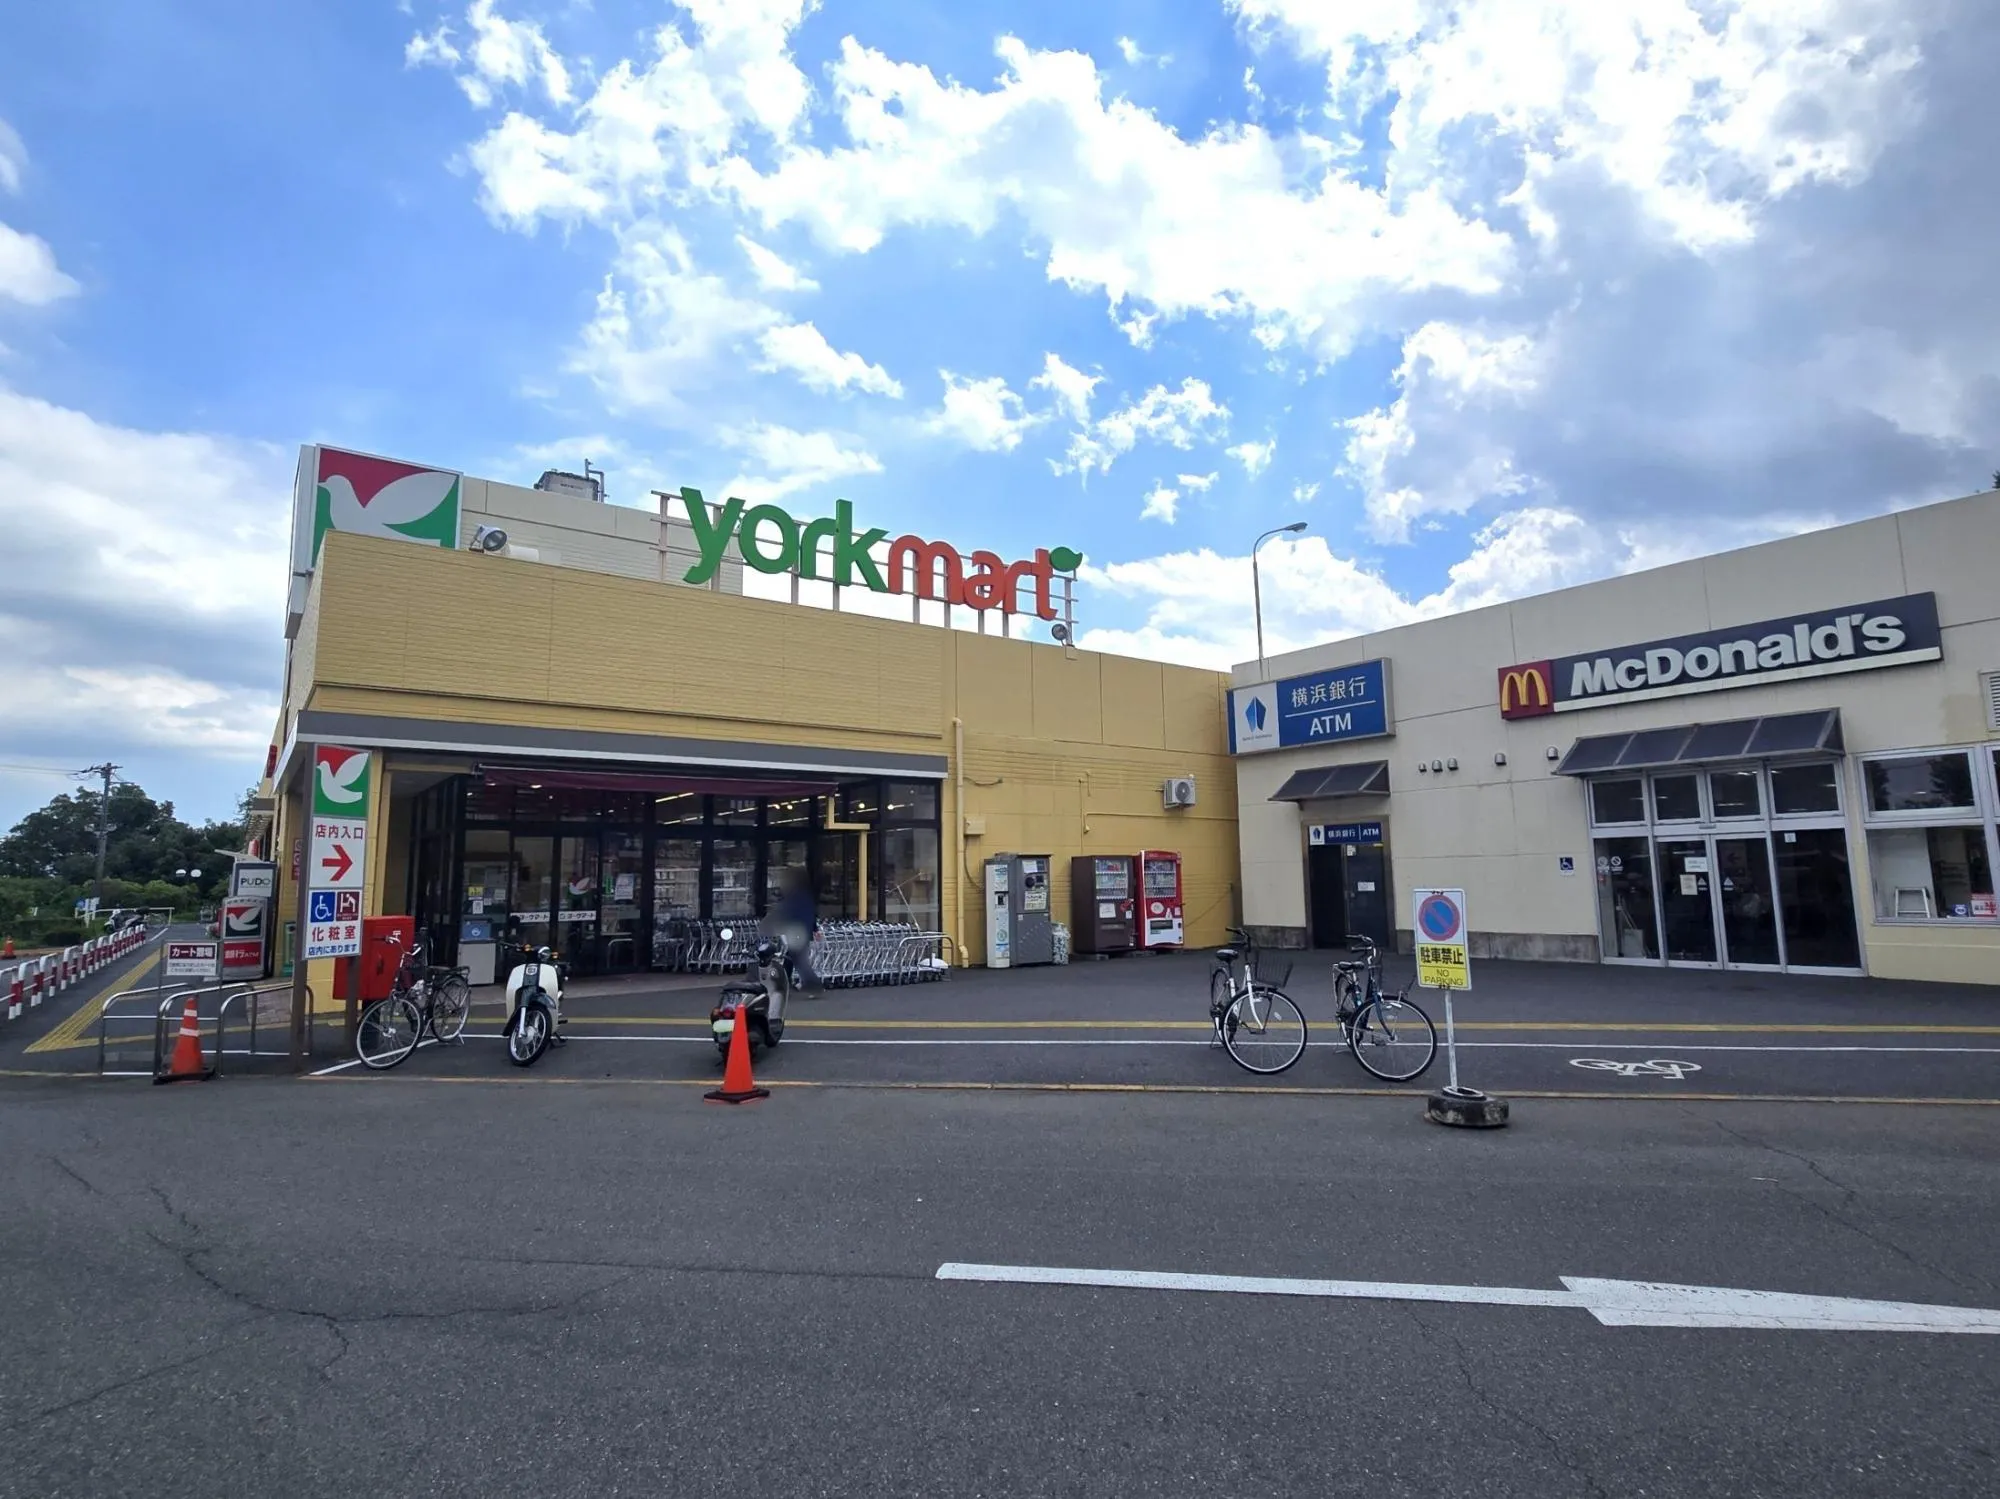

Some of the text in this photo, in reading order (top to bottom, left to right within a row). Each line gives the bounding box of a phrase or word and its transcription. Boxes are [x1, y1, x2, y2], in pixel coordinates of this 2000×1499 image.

[680, 486, 1061, 621] yorkmart
[1571, 613, 1906, 696] McDonald's
[1291, 675, 1366, 708] 横浜銀行
[1309, 712, 1352, 737] ATM
[315, 824, 364, 840] 店内入口
[1362, 828, 1380, 836] ATM
[240, 877, 271, 886] PUDO
[312, 925, 356, 942] 化粧室
[308, 943, 358, 956] 店内にあります
[1420, 946, 1464, 965] 駐車禁止
[1424, 975, 1464, 986] PARKING
[1436, 969, 1450, 978] NO
